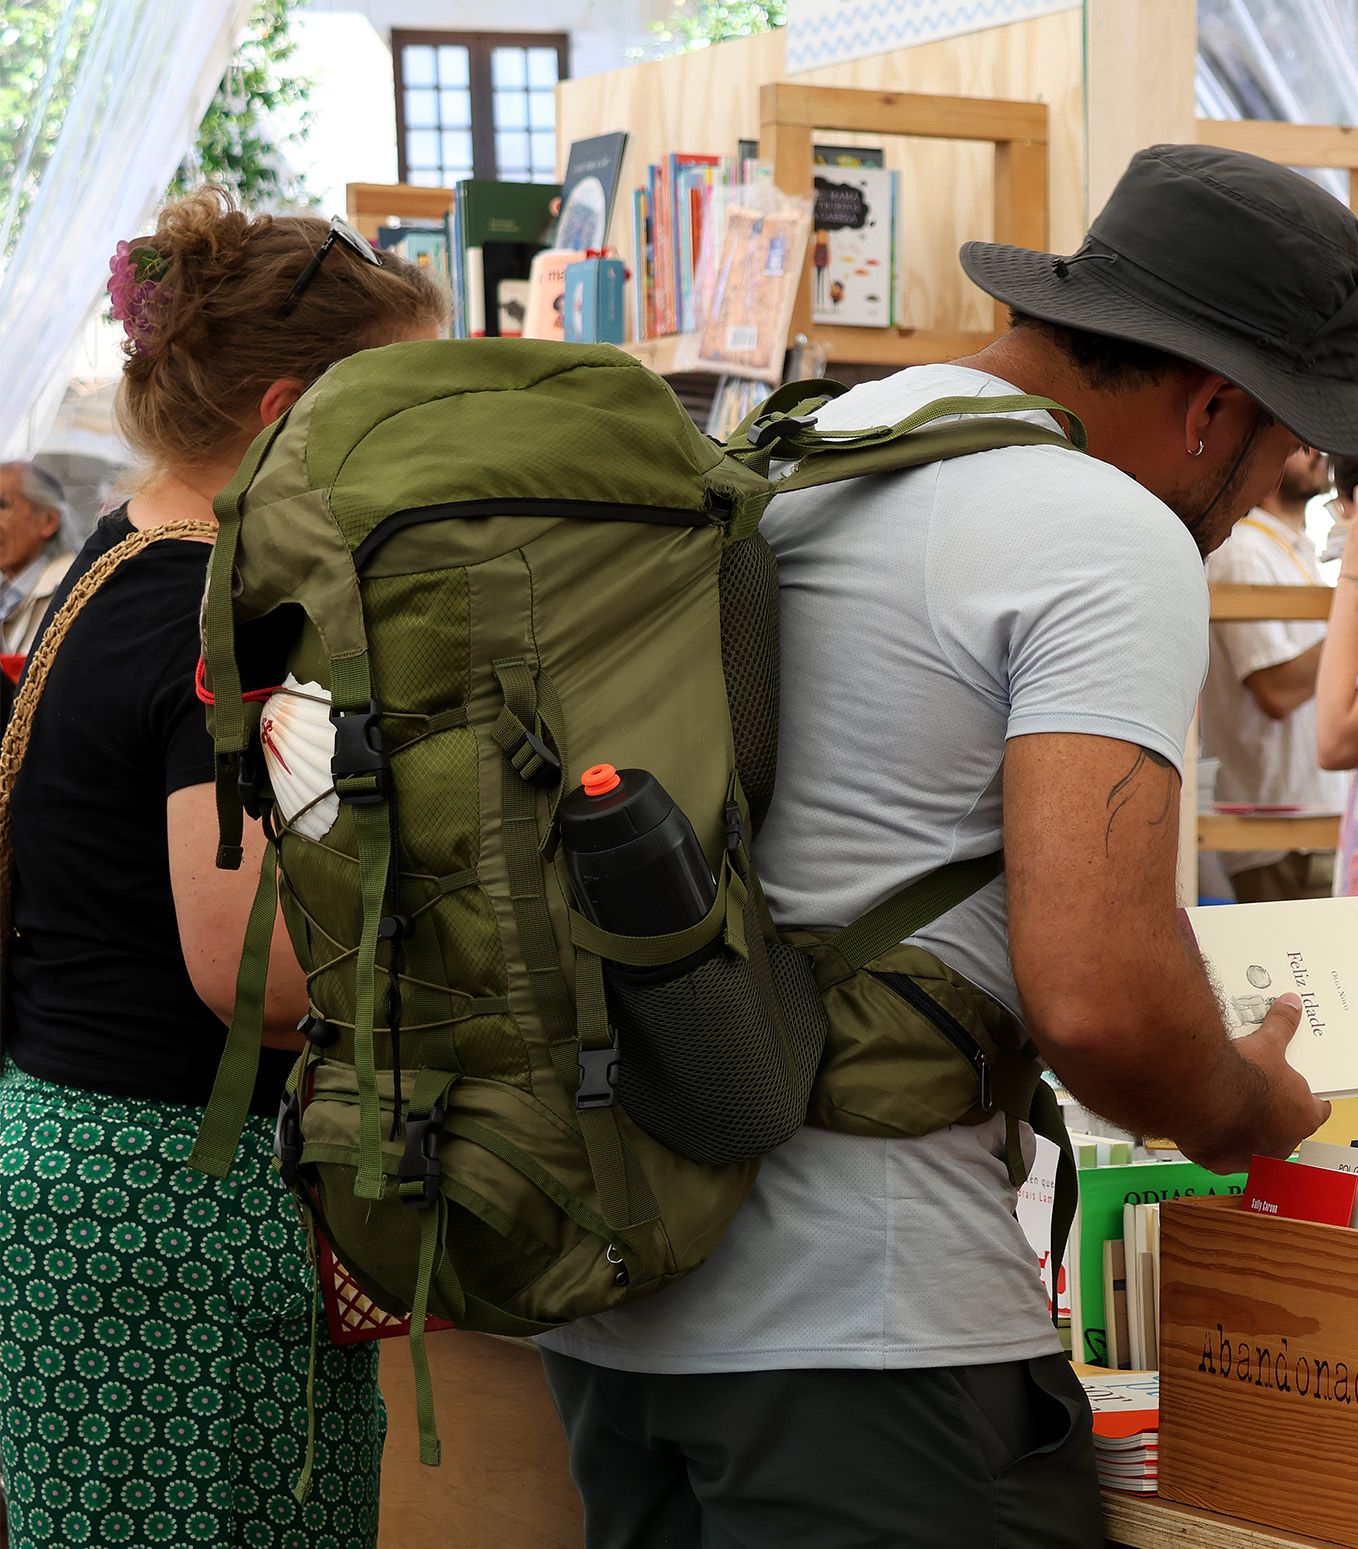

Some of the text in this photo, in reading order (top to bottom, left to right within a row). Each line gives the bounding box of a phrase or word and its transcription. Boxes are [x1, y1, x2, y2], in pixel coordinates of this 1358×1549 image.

[1287, 951, 1326, 1038] Feliz Idade
[1250, 1197, 1263, 1212] Sally
